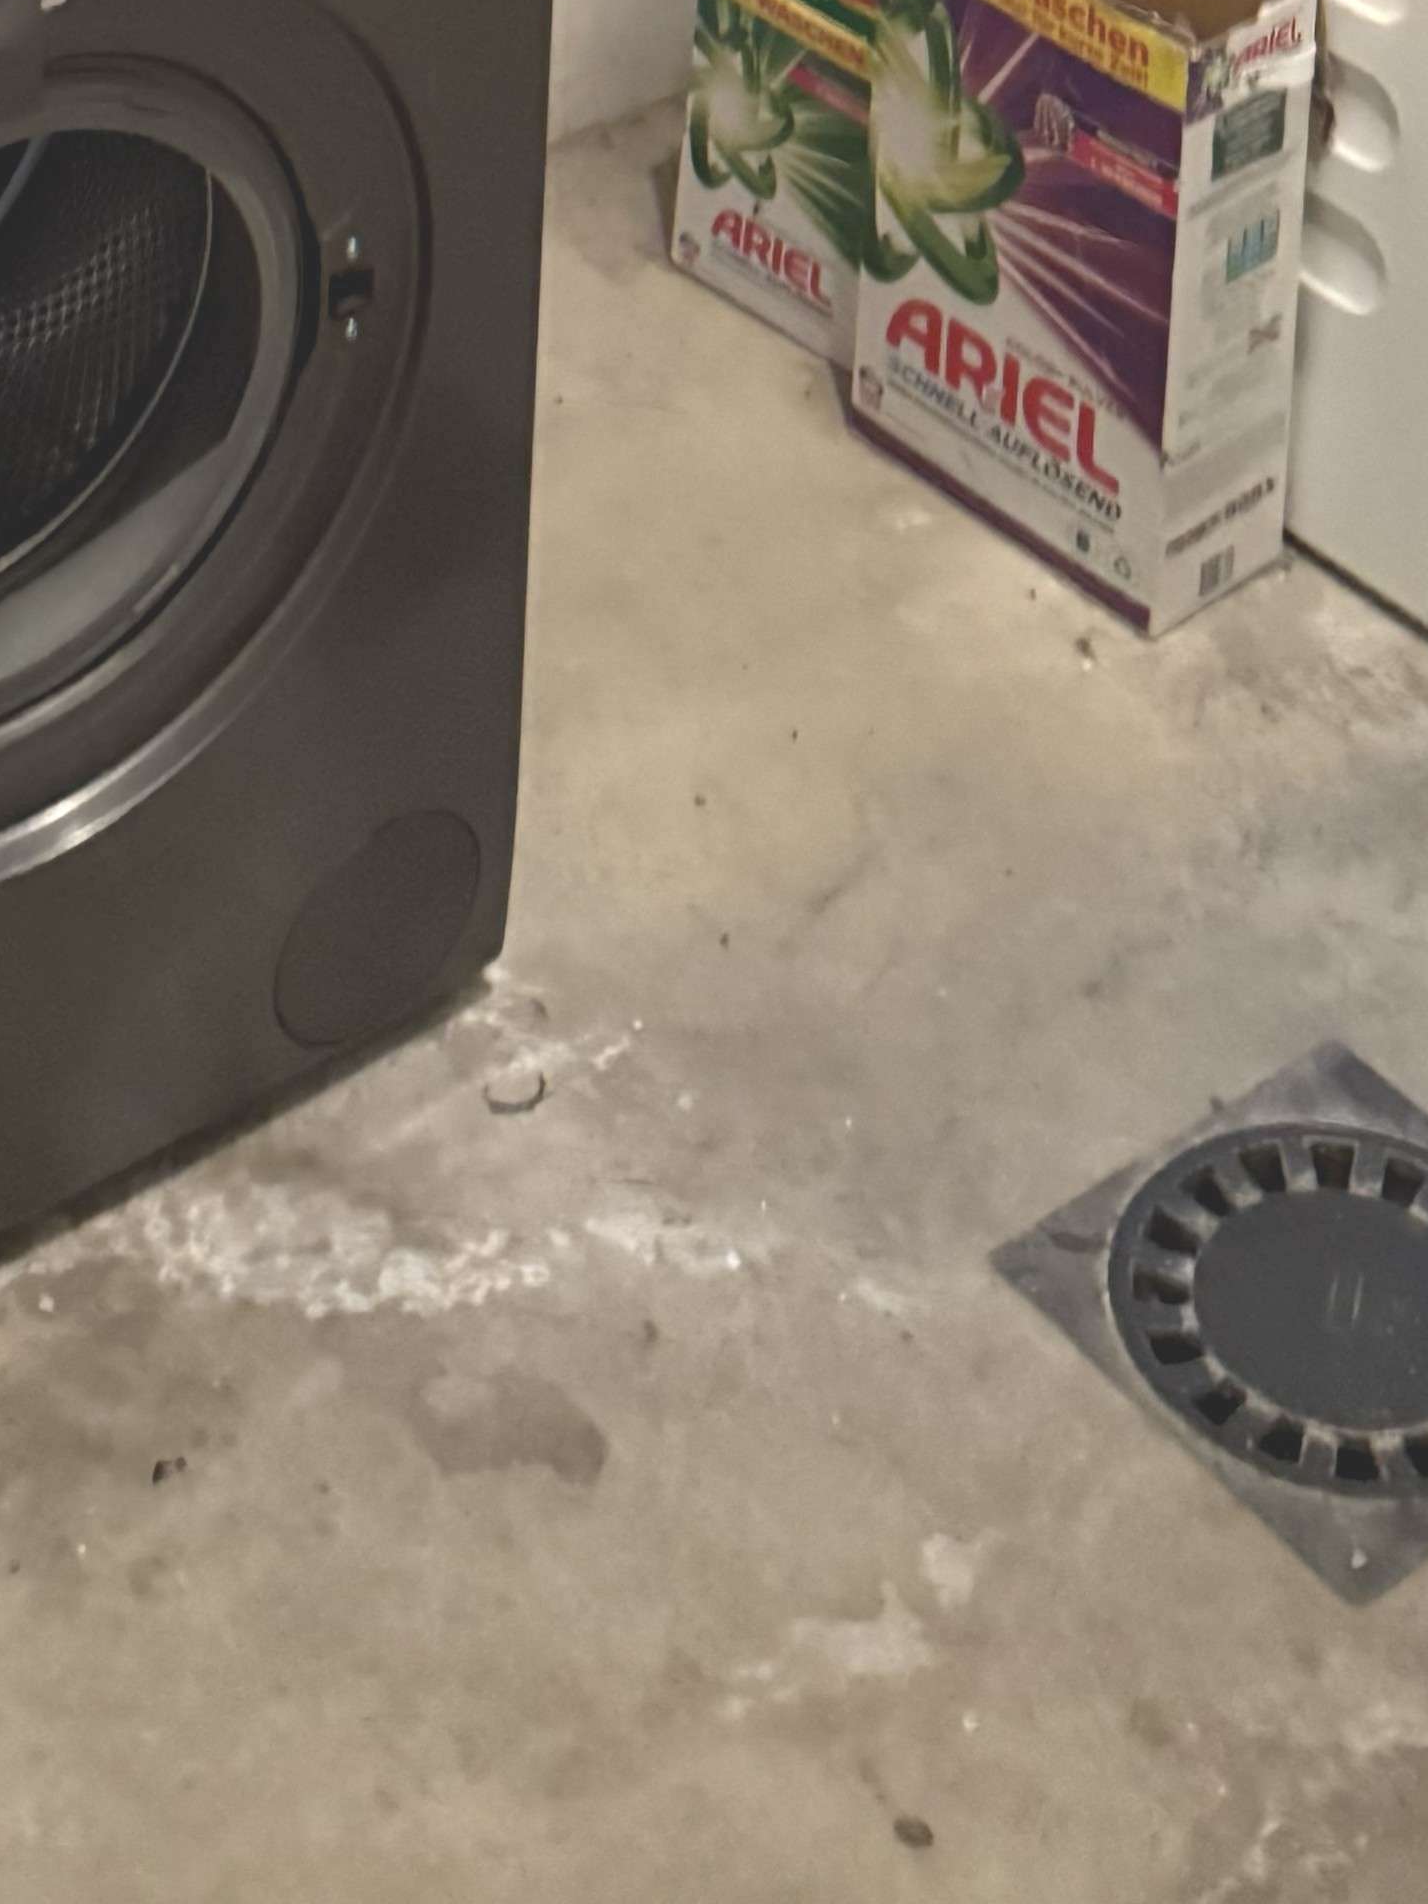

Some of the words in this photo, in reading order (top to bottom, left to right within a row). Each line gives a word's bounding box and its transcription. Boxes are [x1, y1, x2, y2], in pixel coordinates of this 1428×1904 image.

[710, 207, 833, 310] ARIEL
[885, 298, 1120, 498] ARIEL
[887, 352, 979, 432] SCHNELL
